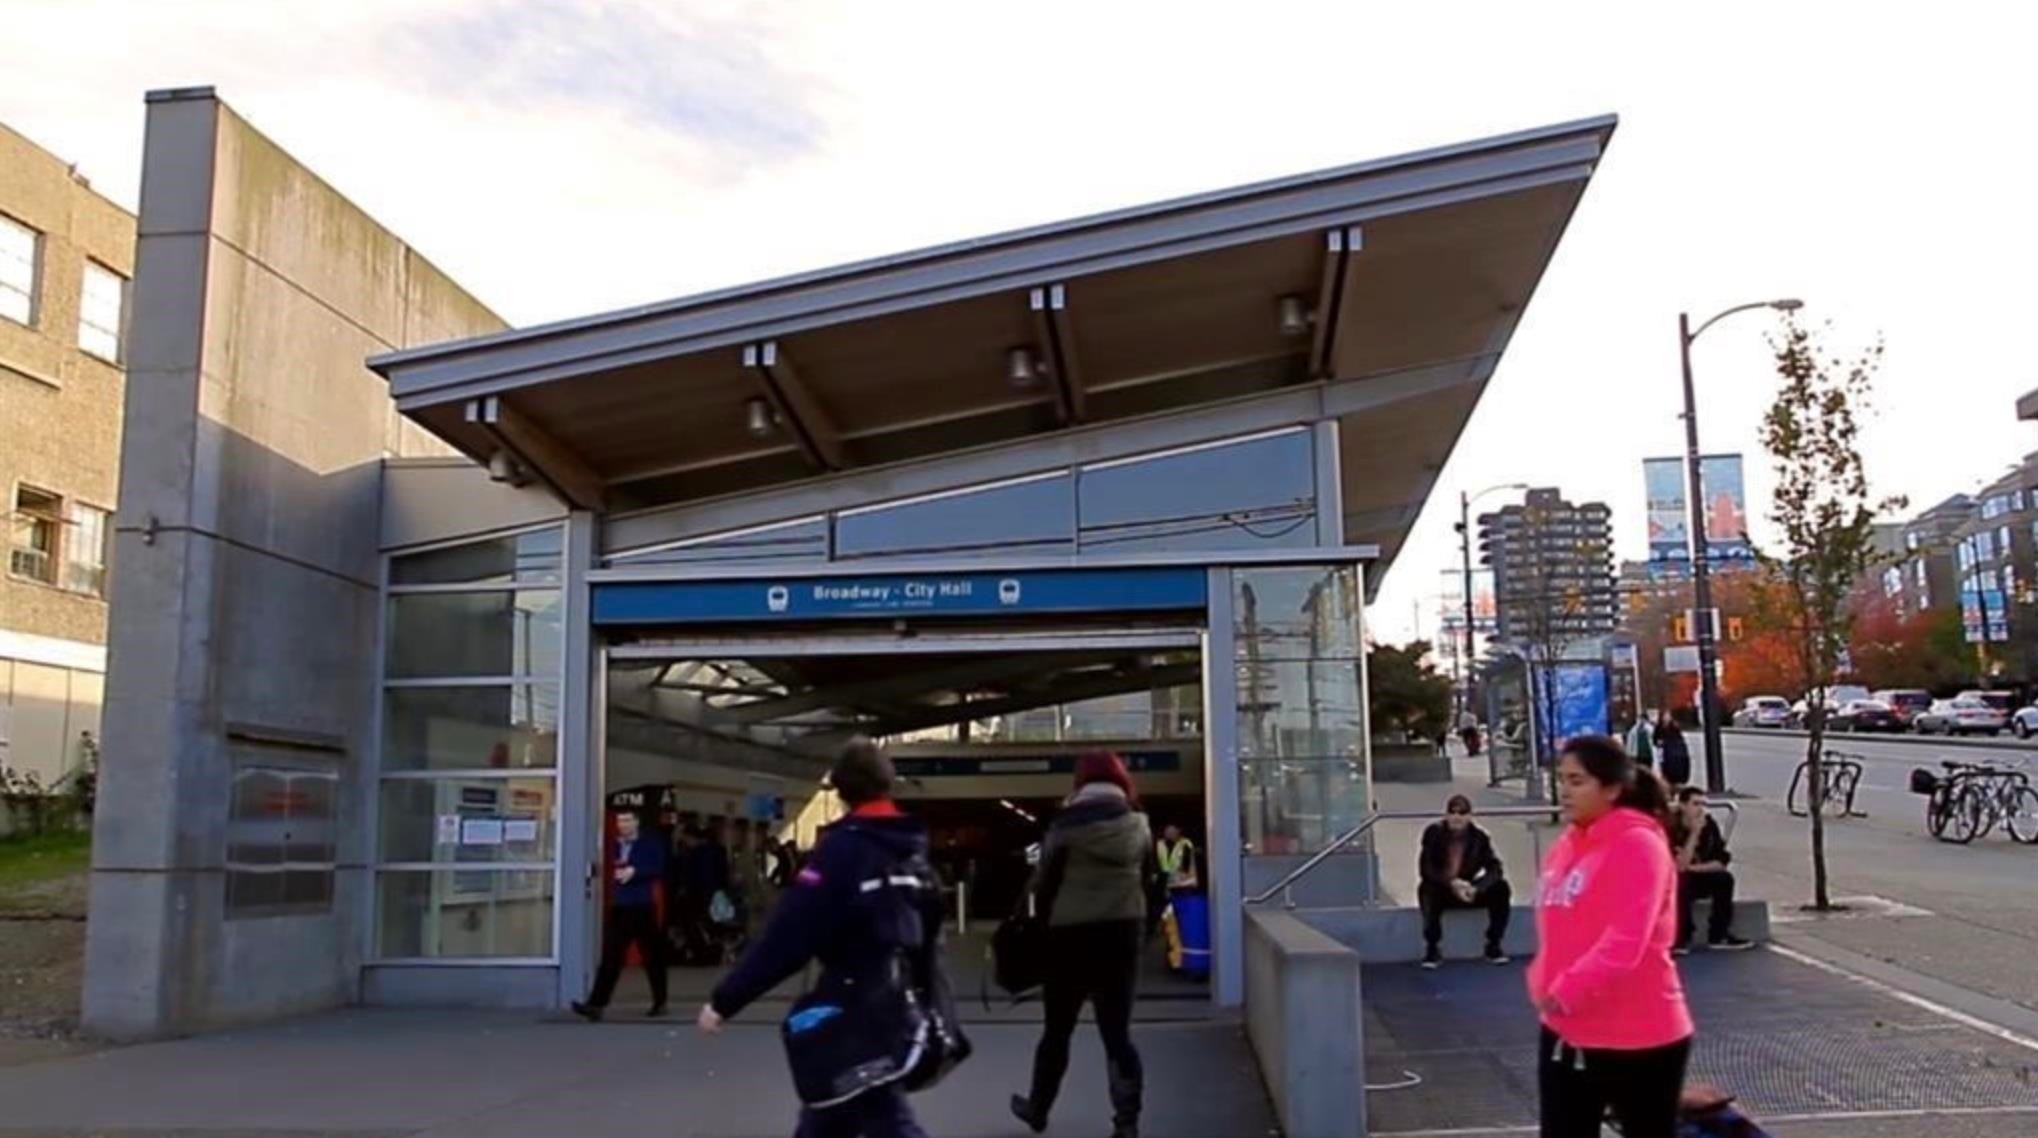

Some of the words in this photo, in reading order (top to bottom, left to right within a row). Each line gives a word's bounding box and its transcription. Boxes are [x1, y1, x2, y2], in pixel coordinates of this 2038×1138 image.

[813, 585, 890, 600] Broadway
[904, 582, 936, 599] City
[940, 581, 973, 596] Hall
[613, 793, 643, 805] ATM
